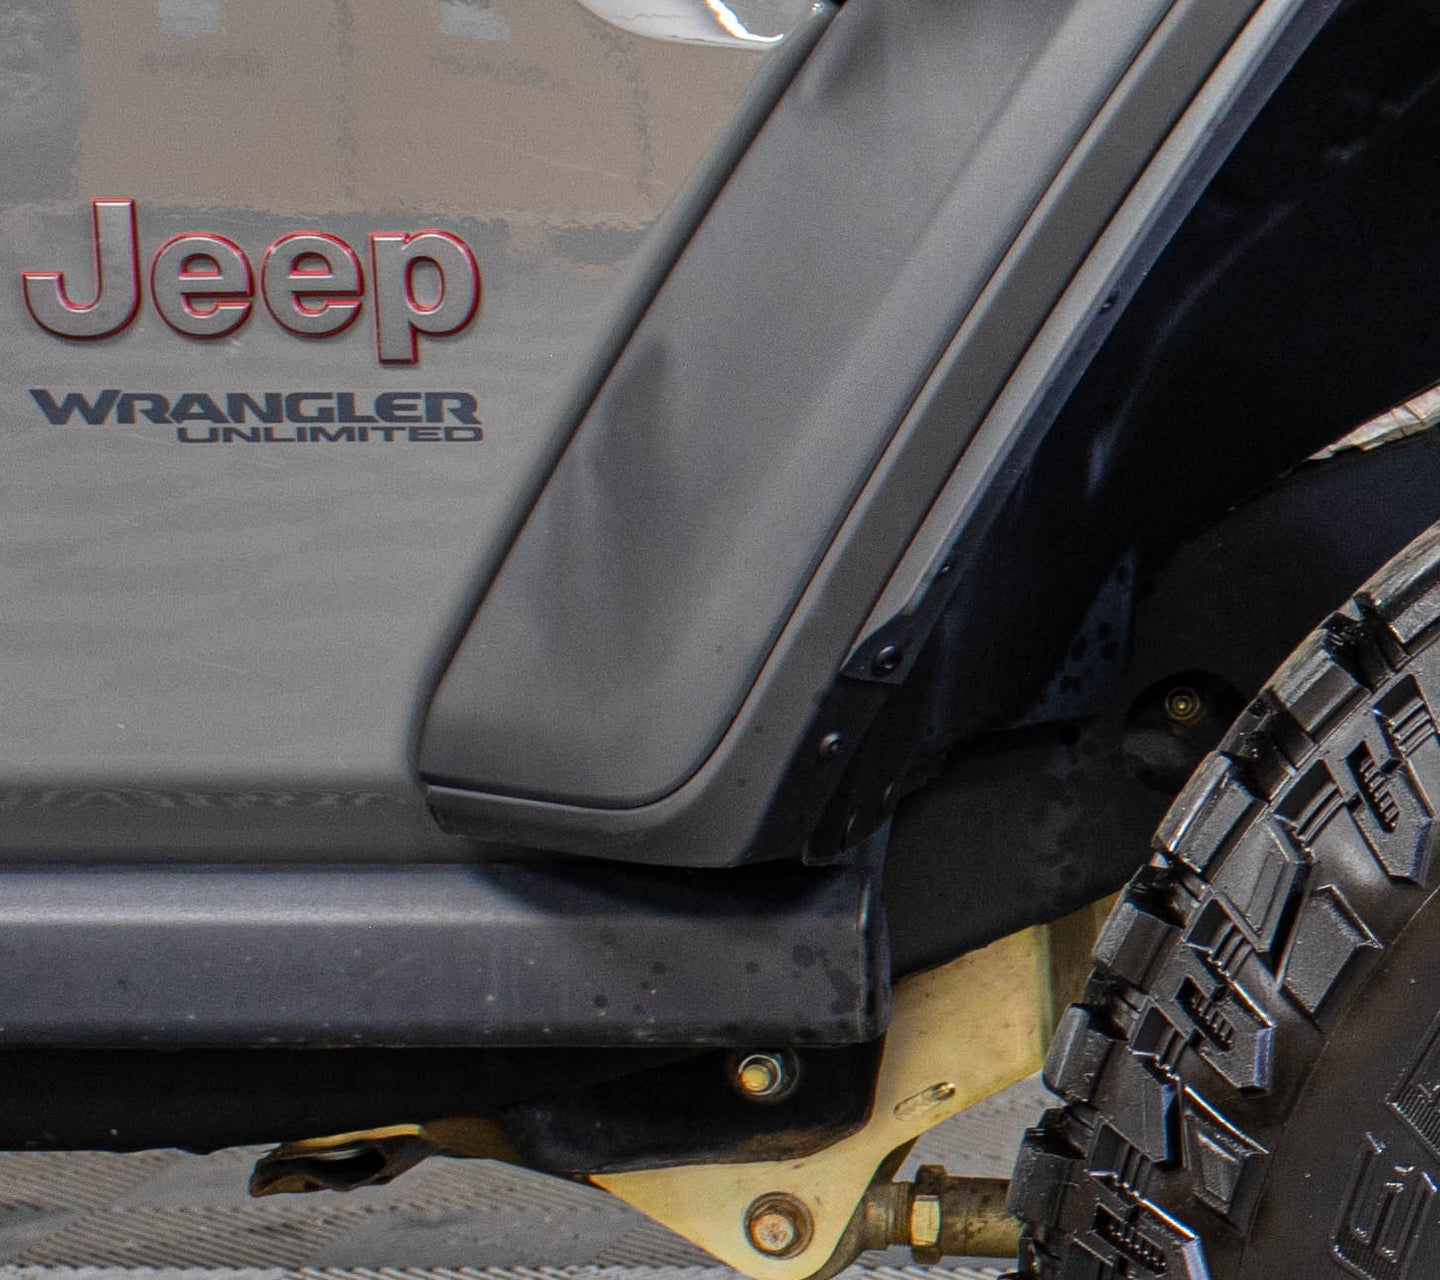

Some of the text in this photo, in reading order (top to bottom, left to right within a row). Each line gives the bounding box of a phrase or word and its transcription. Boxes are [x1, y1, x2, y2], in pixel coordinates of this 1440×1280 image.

[21, 198, 481, 364] Jeep
[28, 388, 482, 425] WRANGLER
[177, 426, 483, 443] UNLIMITED
